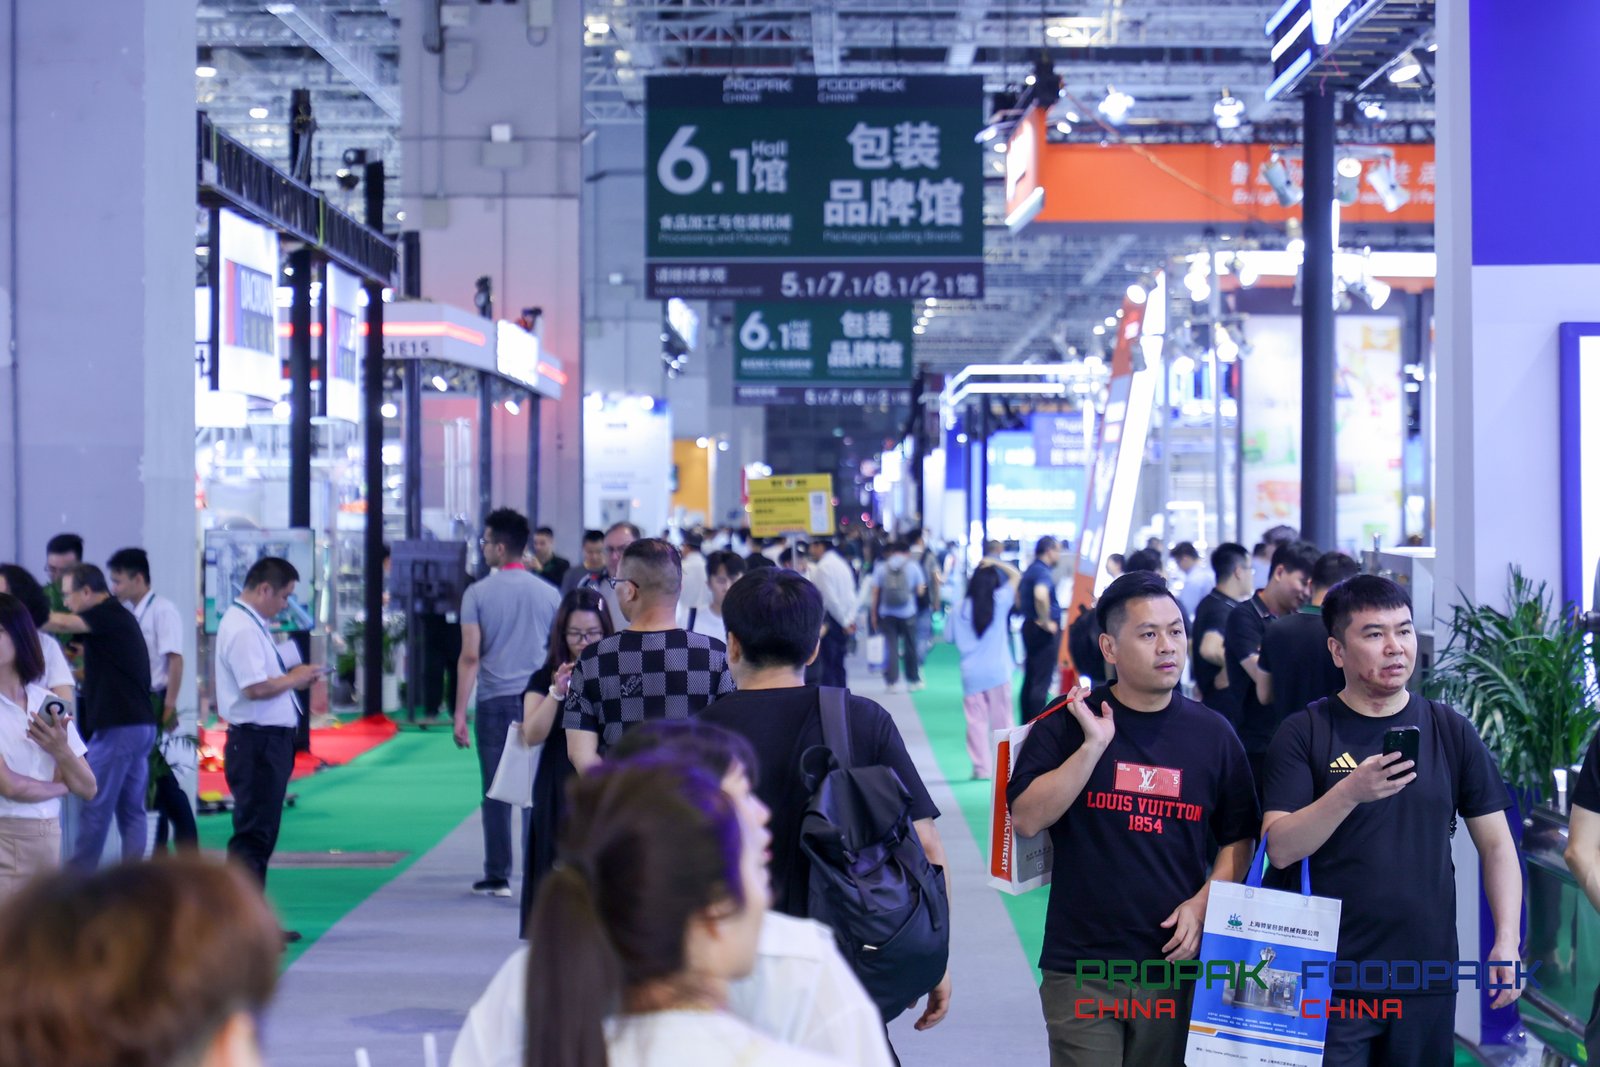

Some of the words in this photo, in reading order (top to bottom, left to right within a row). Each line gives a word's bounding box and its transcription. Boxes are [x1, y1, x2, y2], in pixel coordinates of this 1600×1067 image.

[723, 78, 792, 92] PROPAK
[817, 78, 906, 92] FOODPACK
[723, 93, 762, 103] CHINA
[817, 93, 858, 103] CHINA
[846, 121, 941, 169] 包装
[823, 177, 965, 227] 品牌馆
[1086, 791, 1133, 812] LOUIS
[1137, 797, 1203, 822] VUITTON
[1127, 814, 1163, 834] 1854
